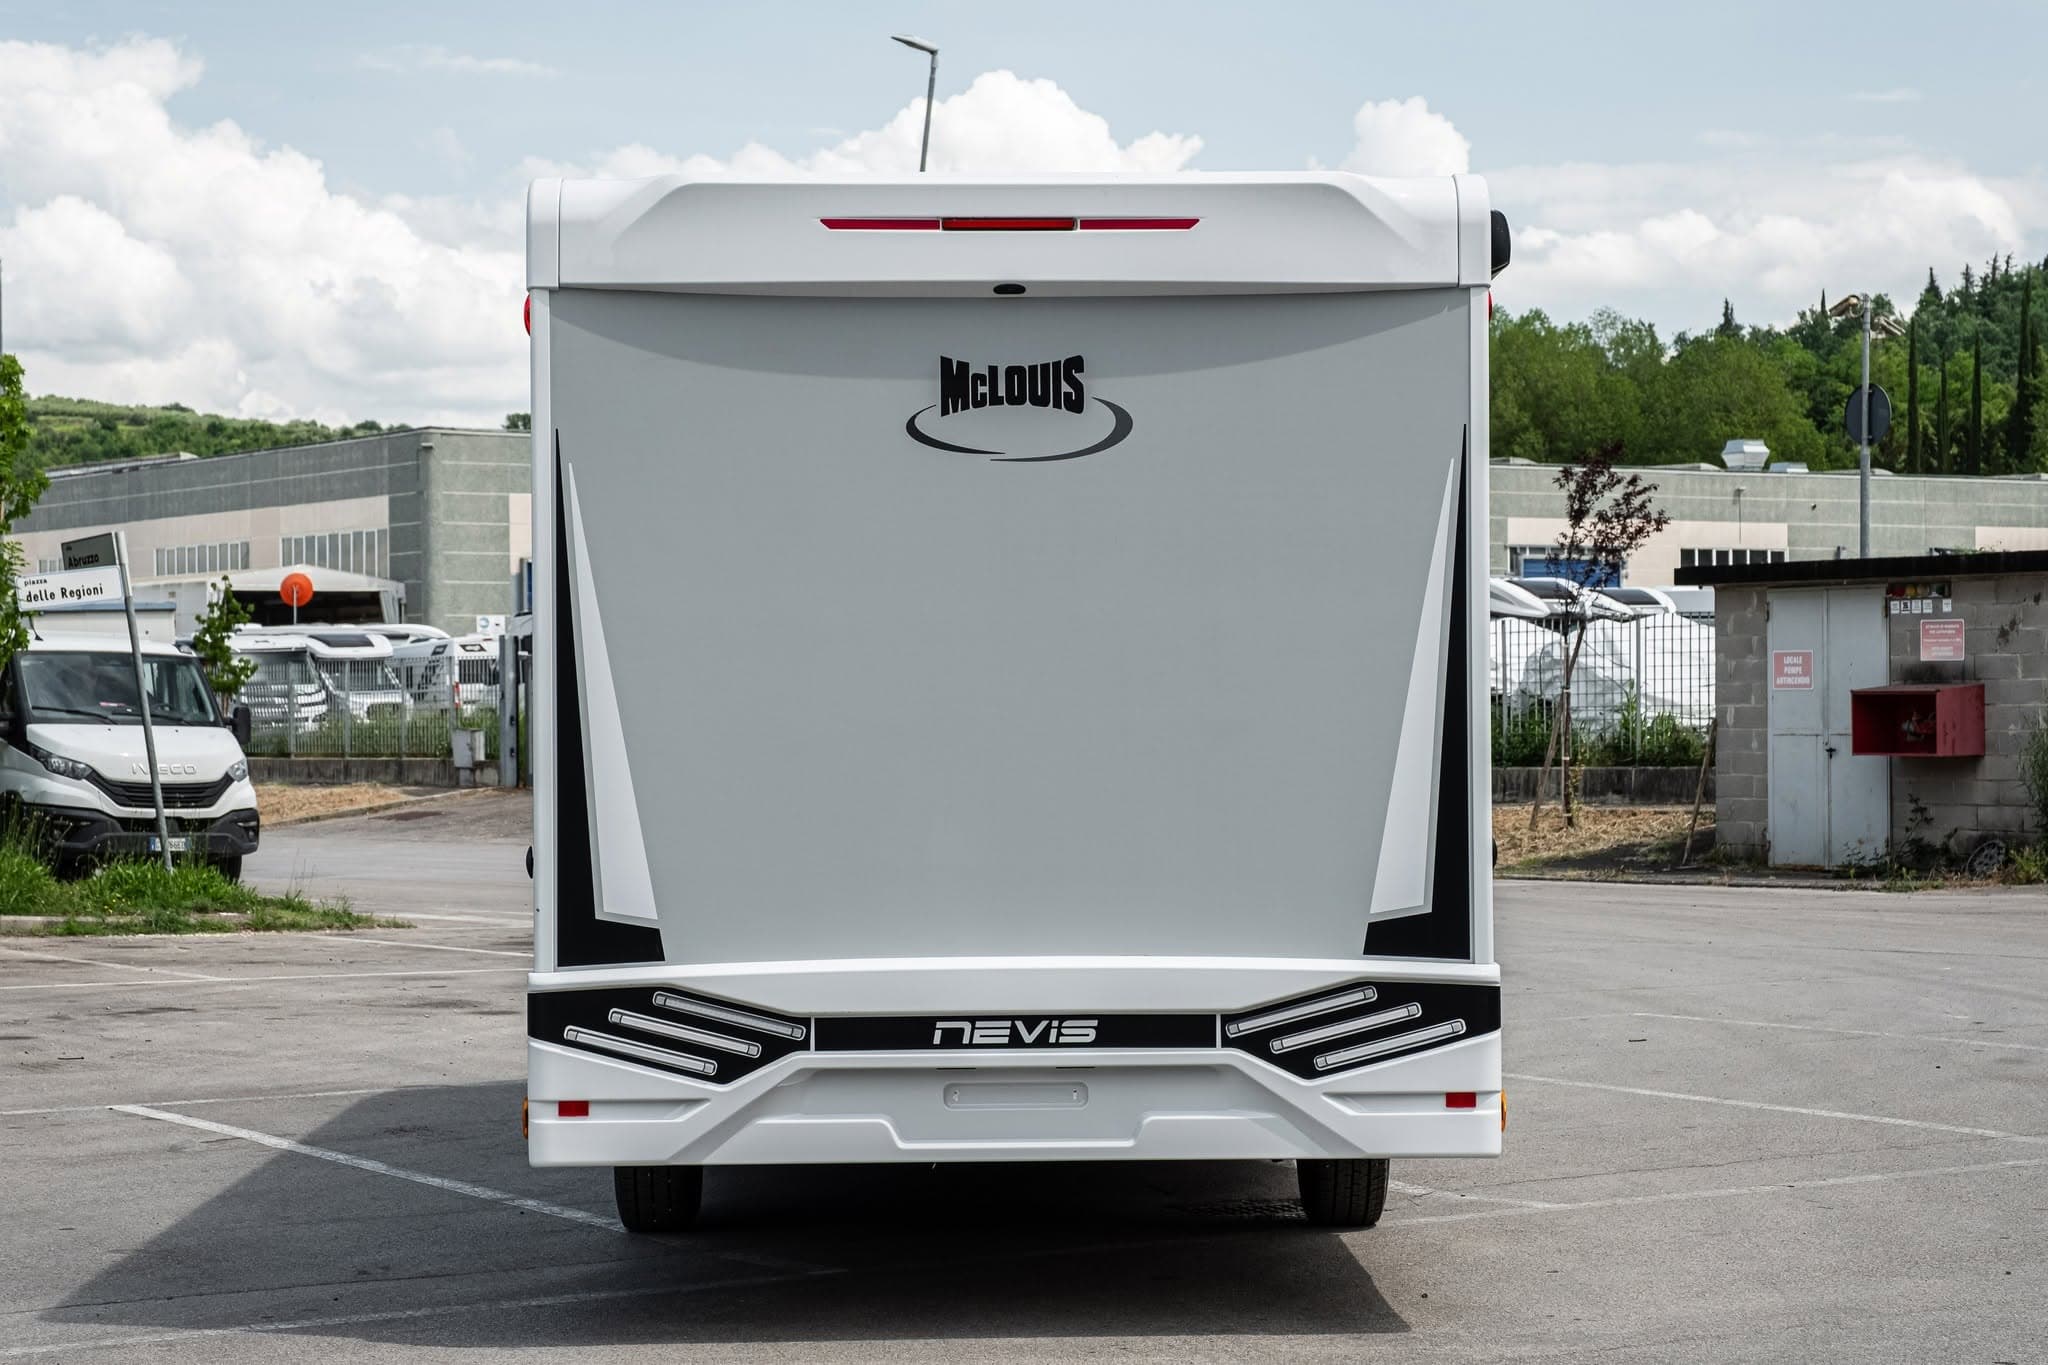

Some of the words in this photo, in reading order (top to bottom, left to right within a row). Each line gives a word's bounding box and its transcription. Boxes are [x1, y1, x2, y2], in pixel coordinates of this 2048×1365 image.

[68, 553, 100, 569] Abruzzo
[24, 578, 48, 587] piazza
[26, 589, 56, 603] delle
[60, 583, 104, 600] Regioni
[1783, 655, 1802, 664] LOCALE
